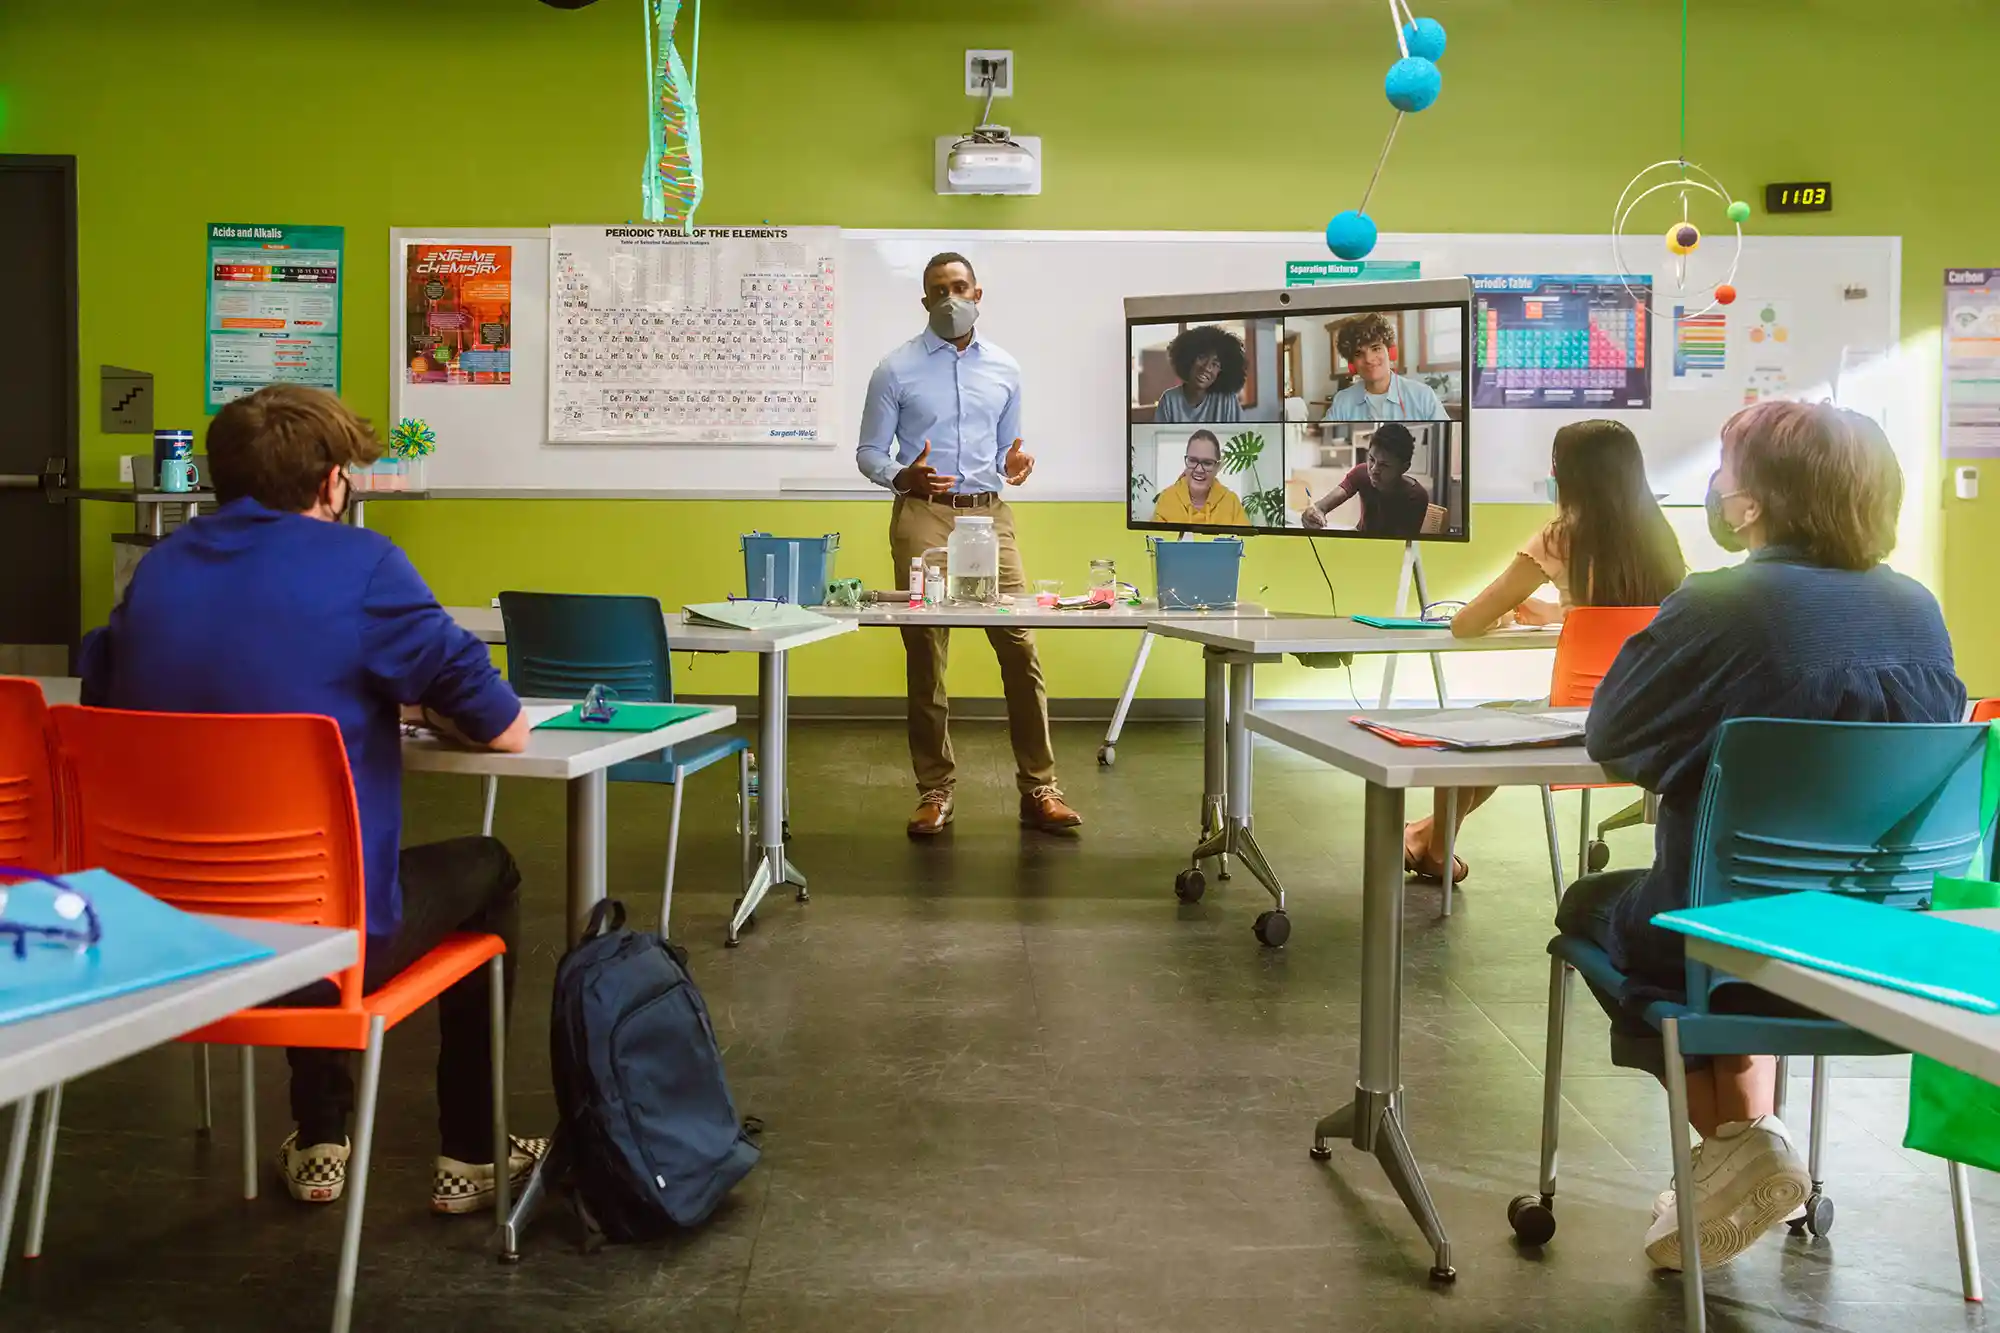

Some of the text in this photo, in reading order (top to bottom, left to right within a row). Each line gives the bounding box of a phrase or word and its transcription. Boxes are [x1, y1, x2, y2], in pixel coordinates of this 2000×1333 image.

[213, 227, 282, 238] Acids and Alkalis
[606, 229, 654, 237] PERIODIC
[692, 230, 706, 238] OF
[732, 230, 788, 238] ELEMENTS
[423, 249, 496, 261] EXTREME
[416, 262, 502, 276] CHEMISTRY
[1290, 265, 1358, 275] Separating Mixtures
[1508, 277, 1533, 288] Table
[1949, 270, 1984, 284] Carbon
